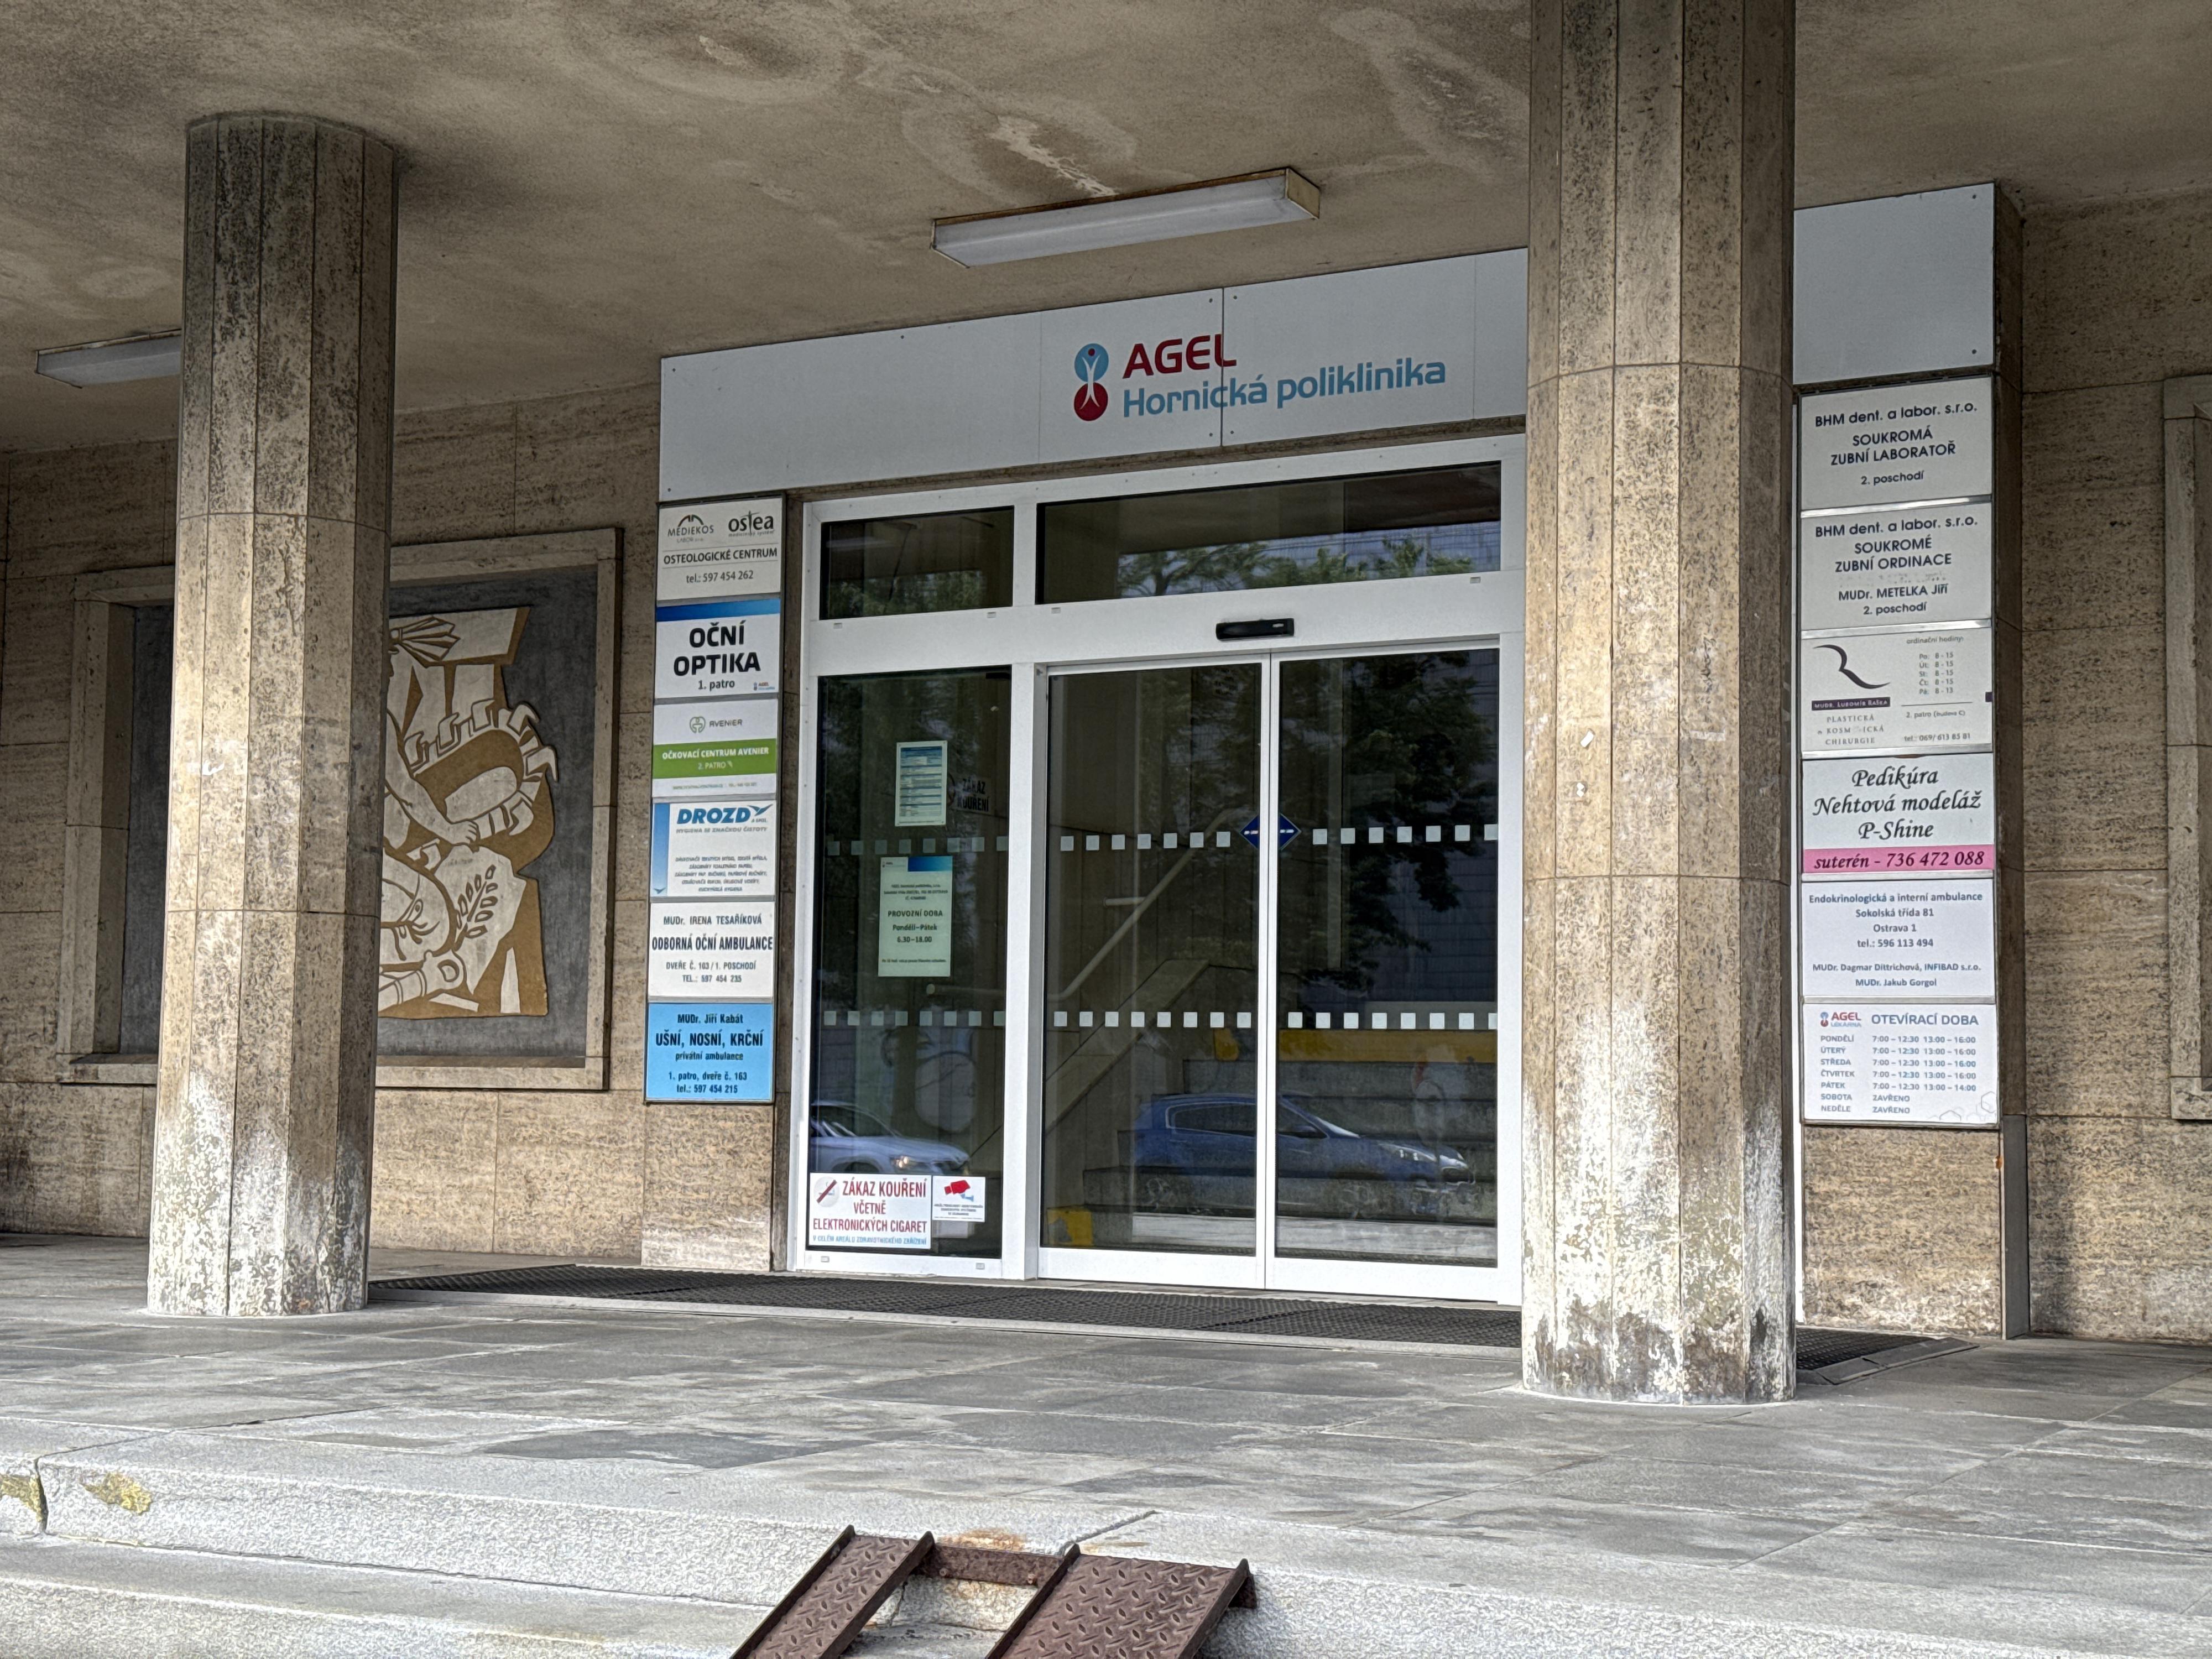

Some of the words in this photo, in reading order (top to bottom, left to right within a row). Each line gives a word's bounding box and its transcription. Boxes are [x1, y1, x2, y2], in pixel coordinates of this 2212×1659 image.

[1122, 333, 1237, 379] AGEL
[1123, 374, 1268, 418] Hornická
[1276, 357, 1446, 409] poliklinika
[1815, 413, 1845, 427] BHM
[1849, 410, 1883, 424] dent.
[1887, 410, 1896, 420] a
[1901, 406, 1941, 418] labor.
[1944, 402, 1978, 414] s.r.o.
[1852, 425, 1933, 446] SOUKROMÁ
[1831, 447, 1870, 466] ZUBNÍ
[1873, 440, 1956, 462] LABORATOŘ
[1861, 476, 1870, 486] 2.
[1873, 469, 1924, 486] poschodí
[728, 510, 774, 535] ostea
[1815, 524, 1845, 538] BHM
[1849, 521, 1884, 535] dent.
[1888, 523, 1897, 532] a
[1901, 519, 1941, 531] labor.
[1945, 517, 1978, 529] s.r.o.
[667, 525, 714, 537] MEDIEKOS
[1854, 534, 1932, 554] SOUKROMÉ
[664, 549, 731, 564] OSTEOLOGICKÉ
[733, 547, 777, 560] CENTRUM
[1835, 555, 1874, 573] ZUBNÍ
[1877, 553, 1952, 570] ORDINACE
[703, 572, 718, 582] 597
[720, 572, 735, 581] 454
[738, 570, 753, 580] 262
[1839, 589, 1873, 601] MUDr.
[1876, 585, 1928, 599] METELKA
[1931, 583, 1948, 595] Jiří
[1863, 606, 1872, 615] 2.
[1876, 601, 1927, 616] poschodí
[689, 619, 746, 648] OČNÍ
[674, 652, 761, 676] OPTIKA
[698, 680, 707, 690] 1.
[709, 680, 735, 691] patro
[709, 719, 743, 728] AVENIER
[1827, 714, 1875, 723] PLASTICKÁ
[1827, 724, 1884, 734] KOSMICKÁ
[662, 749, 700, 760] OČKOVACÍ
[701, 749, 736, 758] CENTRUM
[737, 747, 769, 756] AVENIER
[1851, 765, 1939, 789] Pedikúra
[1812, 794, 1896, 816] Nehtová
[1901, 790, 1983, 811] modeláž
[676, 807, 751, 824] DROZD
[1858, 818, 1934, 840] P-Shine
[1814, 853, 1870, 869] suterén
[1887, 853, 1915, 867] 736
[1919, 852, 1949, 867] 472
[1954, 851, 1984, 866] 088
[1809, 894, 1887, 904] Endokrinologická
[1897, 892, 1929, 902] interní
[1931, 891, 1983, 901] ambulance
[663, 916, 685, 925] MUDr.
[690, 916, 712, 925] IRENA
[716, 913, 762, 925] TESAŘÍKOVÁ
[888, 909, 922, 917] PROVOZNÍ
[1855, 908, 1896, 918] Sokolská
[1898, 907, 1920, 917] třída
[1922, 908, 1934, 917] 81
[1873, 924, 1908, 932] Ostrava
[652, 933, 692, 951] ODBORNÁ
[695, 933, 718, 950] OČNÍ
[719, 936, 773, 950] AMBULANCE
[1877, 938, 1895, 947] 596
[1897, 938, 1914, 947] 113
[1916, 938, 1933, 947] 494
[666, 961, 686, 969] DVEŘE
[723, 961, 757, 969] POSCHODÍ
[1840, 963, 1872, 973] Dagmar
[1884, 978, 1907, 987] Jakub
[1909, 978, 1937, 988] Gorgol
[677, 1014, 701, 1024] MUDr.
[704, 1013, 717, 1024] Jiří
[720, 1014, 744, 1024] Kabát
[1831, 1012, 1862, 1021] AGEL
[1871, 1013, 1938, 1025] OTEVÍRACÍ
[1942, 1014, 1979, 1026] DOBA
[655, 1029, 685, 1048] UŠNÍ,
[689, 1029, 725, 1048] NOSNÍ,
[730, 1029, 764, 1046] KRČNÍ
[675, 1051, 703, 1062] privátní
[705, 1051, 743, 1060] ambulance
[678, 1072, 699, 1082] patro,
[702, 1071, 722, 1080] dveře
[734, 1072, 747, 1081] 163
[1820, 1070, 1855, 1078] ČTVRTEK
[693, 1084, 706, 1093] 597
[709, 1084, 722, 1093] 454
[724, 1085, 738, 1093] 215
[1820, 1081, 1845, 1089] PÁTEK
[1872, 1093, 1910, 1102] ZAVŘENO
[842, 1177, 876, 1197] ZÁKAZ
[879, 1177, 928, 1198] KOUŘENÍ
[853, 1199, 886, 1215] VČETNĚ
[812, 1217, 888, 1232] ELEKTRONICKÝCH
[890, 1220, 927, 1233] CIGARET
